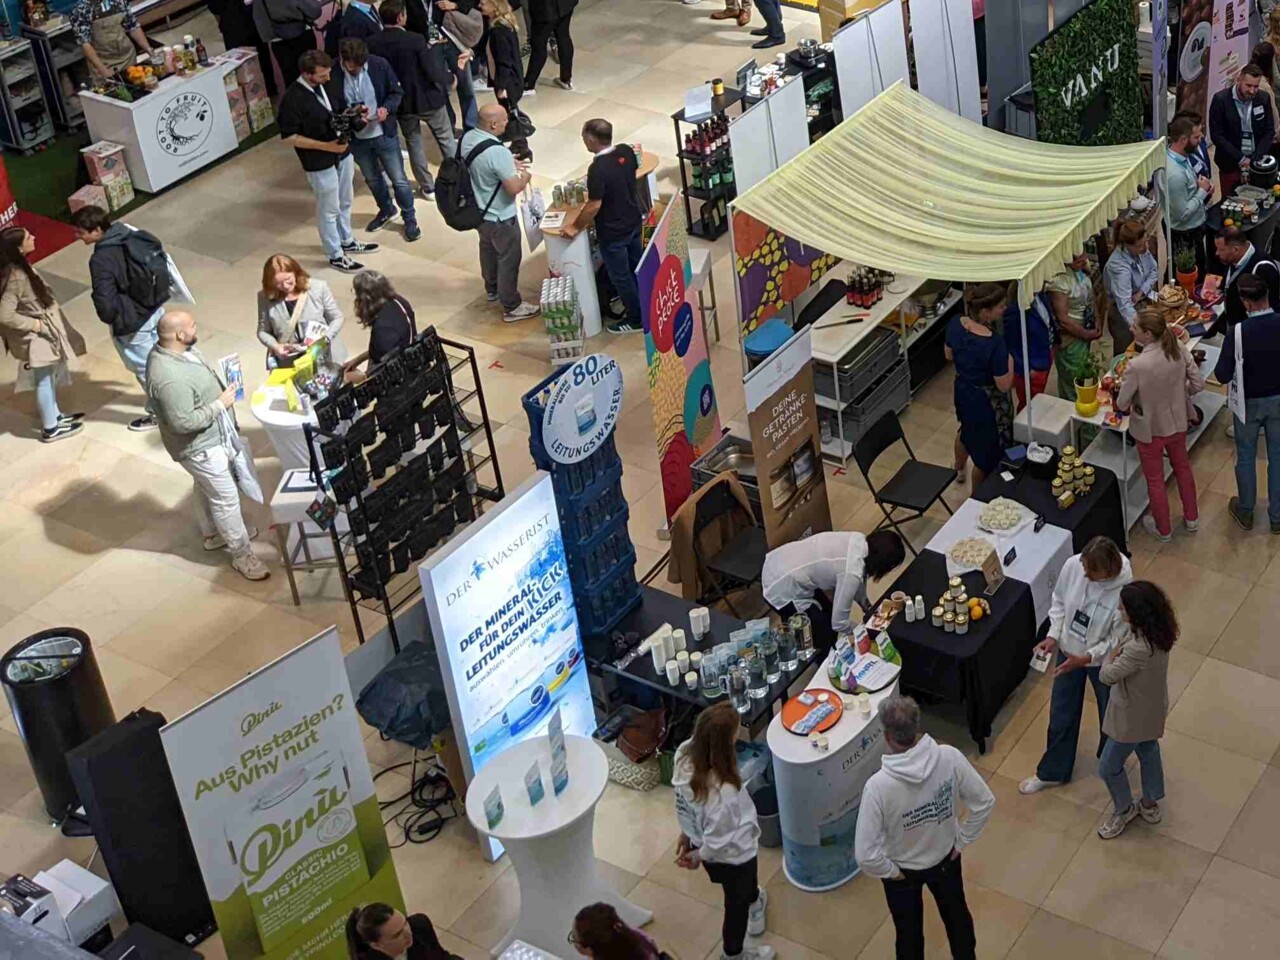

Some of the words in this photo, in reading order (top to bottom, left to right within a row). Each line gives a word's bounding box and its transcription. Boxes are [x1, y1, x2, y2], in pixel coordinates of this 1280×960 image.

[176, 95, 207, 108] FRUIT
[0, 201, 19, 221] HER
[572, 355, 598, 386] 80
[590, 359, 617, 386] LITER
[564, 384, 571, 394] ZU
[772, 389, 797, 417] DEINE
[551, 386, 621, 458] LEITUNGSWASSER
[762, 392, 808, 438] GETRÄNKE-
[772, 409, 804, 442] PASTEN
[446, 579, 473, 607] DER
[486, 512, 551, 572] WASSERIST
[459, 626, 484, 653] DER
[485, 581, 538, 632] MINERAL-
[478, 629, 500, 653] FÜR
[500, 606, 525, 632] DEIN
[526, 564, 564, 612] KICK
[465, 590, 563, 681] LEITUNGSWASSER
[855, 659, 878, 681] MNRL
[195, 766, 238, 801] Aus
[240, 693, 345, 769] Pistazien?
[227, 756, 280, 794] Why
[284, 729, 320, 762] nut
[842, 751, 861, 771] DER
[262, 843, 350, 908] PISTACHIO
[284, 850, 324, 881] CLASSIC
